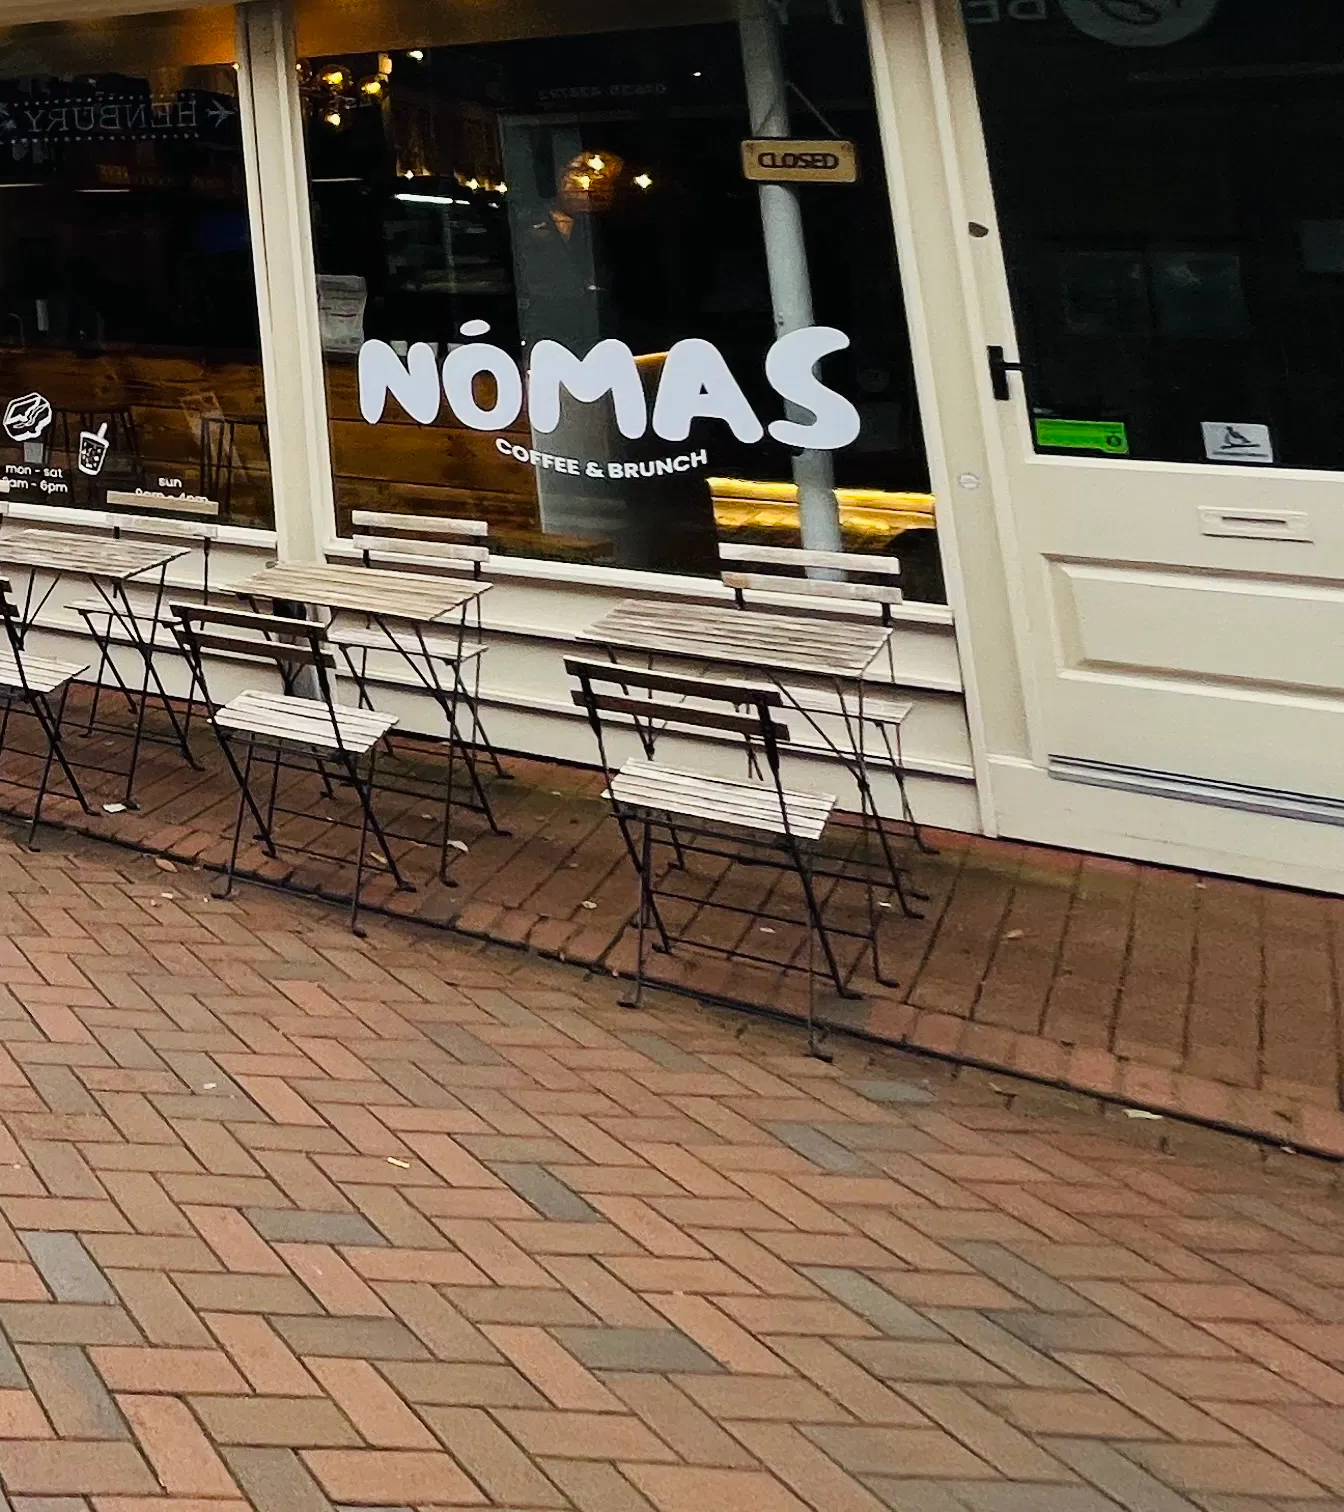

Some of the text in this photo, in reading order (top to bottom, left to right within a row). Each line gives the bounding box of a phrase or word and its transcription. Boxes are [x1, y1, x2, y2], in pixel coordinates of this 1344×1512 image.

[757, 150, 839, 172] CLOSED
[495, 437, 709, 480] COFFEE & BRUNCH
[5, 464, 32, 475] mon
[43, 467, 63, 479] sat
[39, 480, 69, 494] 6pm
[159, 477, 183, 488] sun
